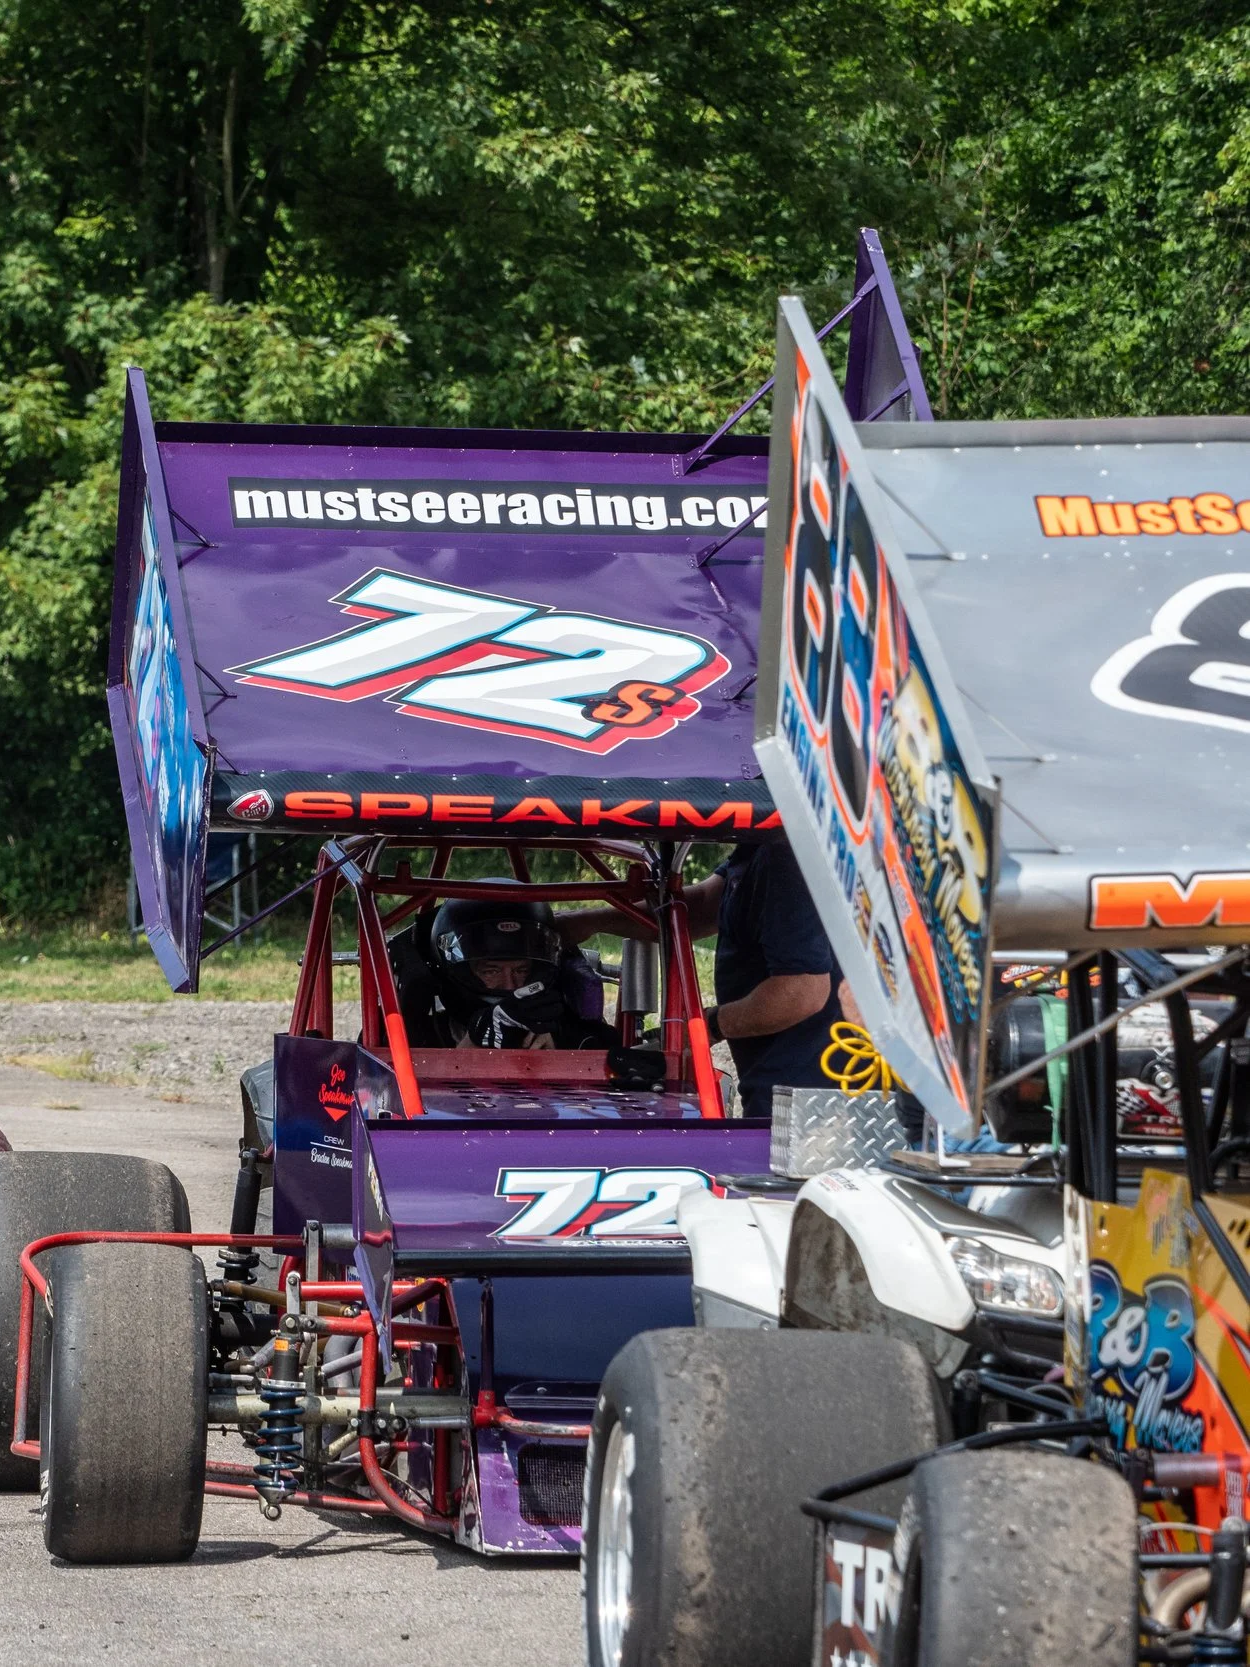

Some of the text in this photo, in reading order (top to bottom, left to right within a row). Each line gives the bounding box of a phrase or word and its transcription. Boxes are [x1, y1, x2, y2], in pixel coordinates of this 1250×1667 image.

[234, 570, 718, 746] 72
[323, 1135, 345, 1146] CREW
[490, 1168, 712, 1238] 72
